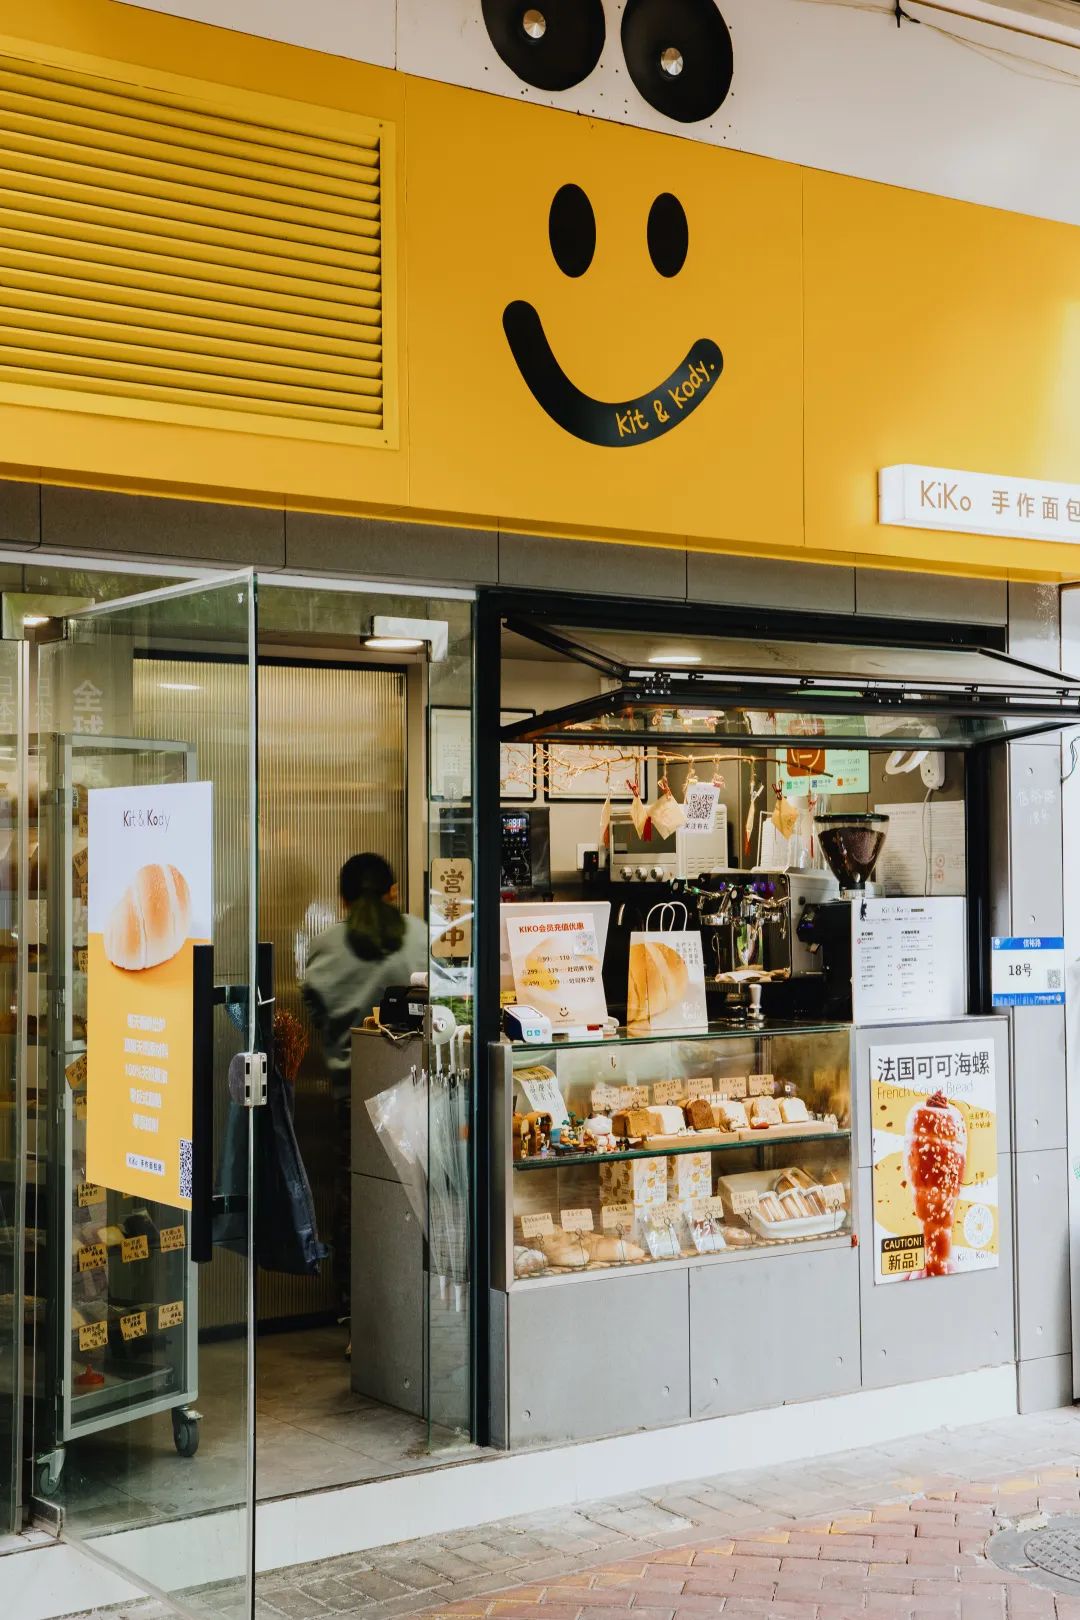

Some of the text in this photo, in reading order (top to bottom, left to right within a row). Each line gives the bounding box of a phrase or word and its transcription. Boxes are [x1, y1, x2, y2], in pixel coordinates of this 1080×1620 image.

[615, 360, 717, 438] kit & kody.
[919, 479, 1080, 523] KiKo 手作面包
[1008, 962, 1033, 978] 18号
[876, 1050, 990, 1083] 法国可可海螺
[876, 1085, 911, 1100] French
[883, 1236, 923, 1250] CAUTION!
[888, 1252, 918, 1271] 新品!
